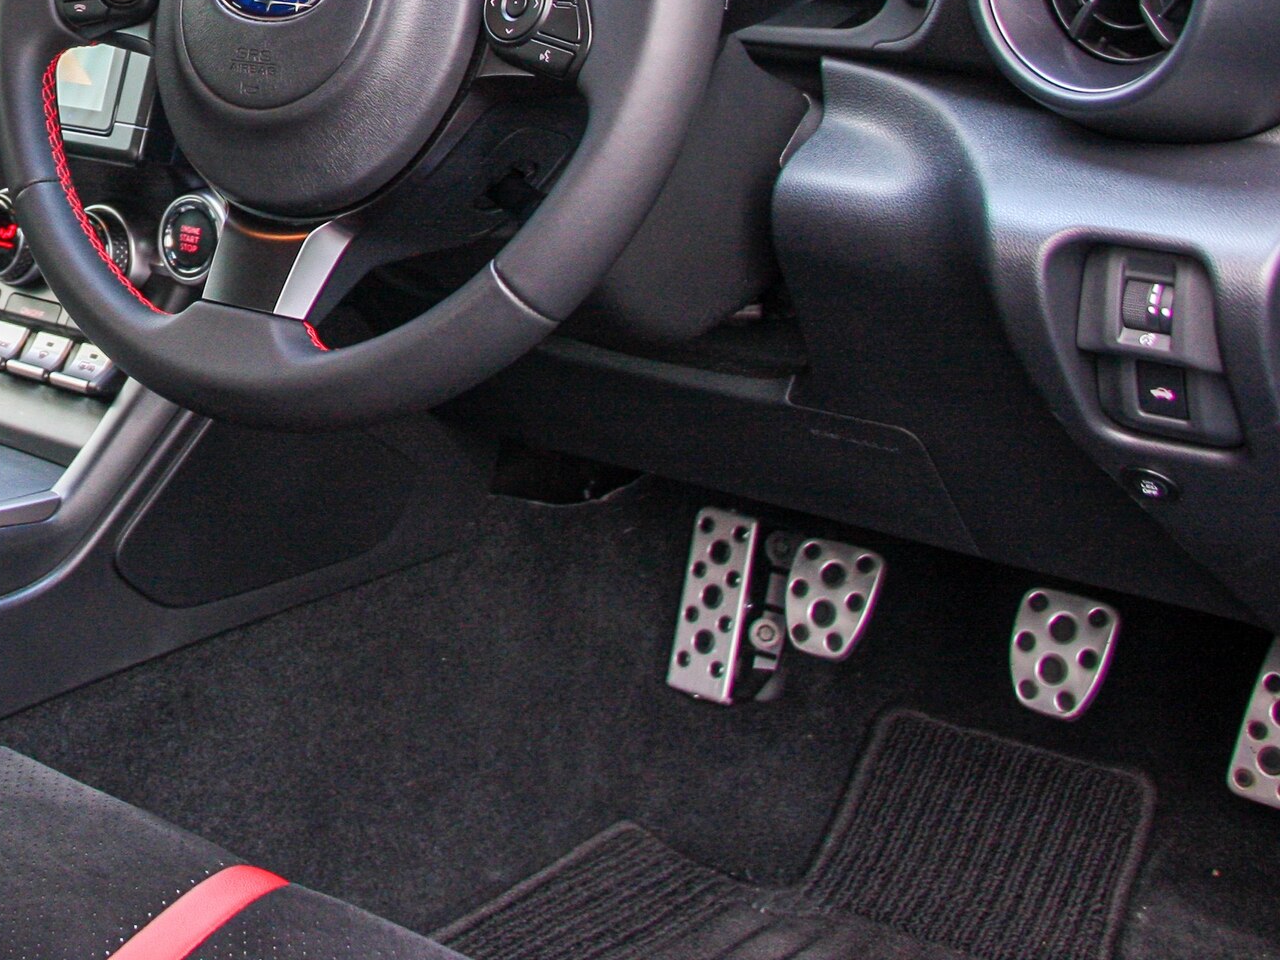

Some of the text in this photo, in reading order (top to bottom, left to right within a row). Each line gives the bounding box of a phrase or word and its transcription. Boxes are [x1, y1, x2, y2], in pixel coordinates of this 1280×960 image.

[236, 47, 272, 61] SRS
[179, 233, 200, 244] START
[179, 242, 199, 253] STOP
